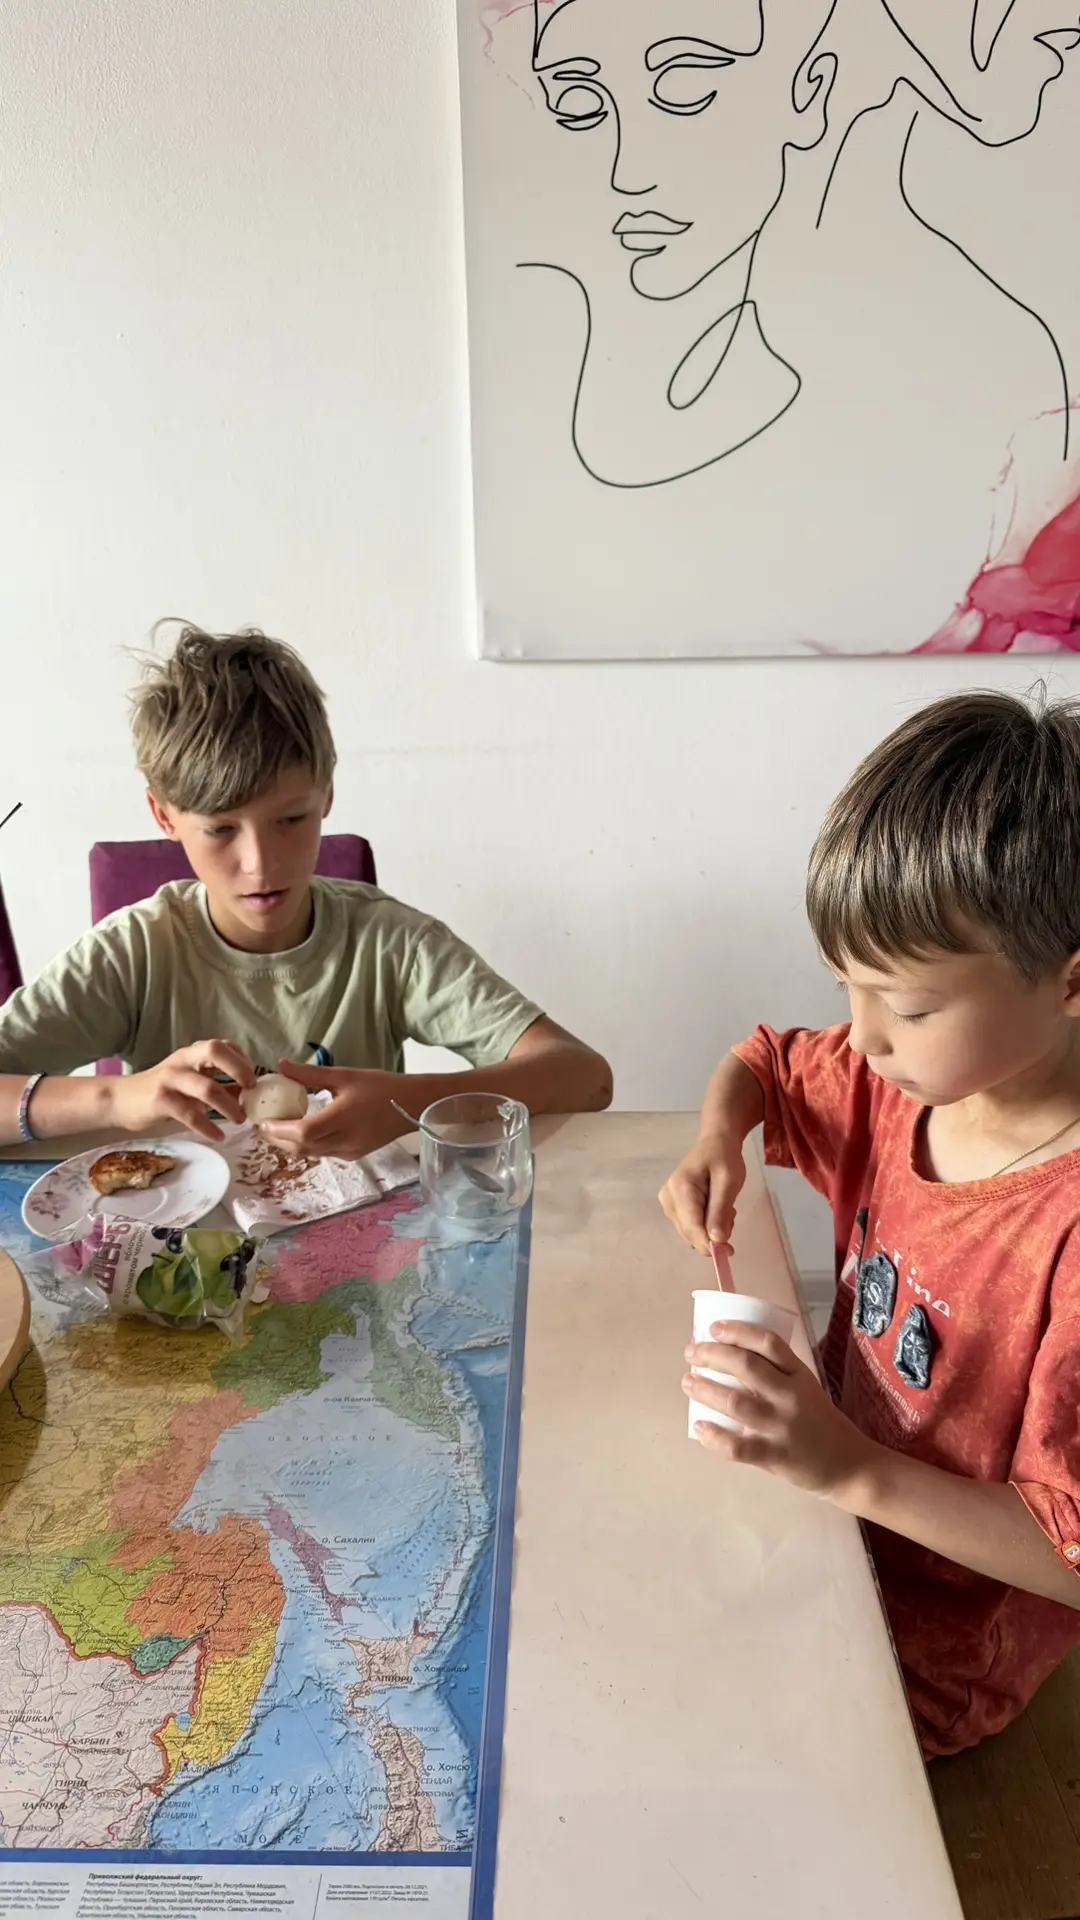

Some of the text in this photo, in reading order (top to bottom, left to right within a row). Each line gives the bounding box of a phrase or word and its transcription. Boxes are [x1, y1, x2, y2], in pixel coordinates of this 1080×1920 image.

[334, 1535, 376, 1543] Сахалин
[438, 1762, 470, 1771] Хонсю
[420, 1776, 453, 1784] СЕНДАЙ
[211, 1785, 352, 1796] ЯПОНСКОЕ
[22, 1802, 68, 1810] ЧАНЧУНЬ
[238, 1835, 303, 1844] МОРЕ
